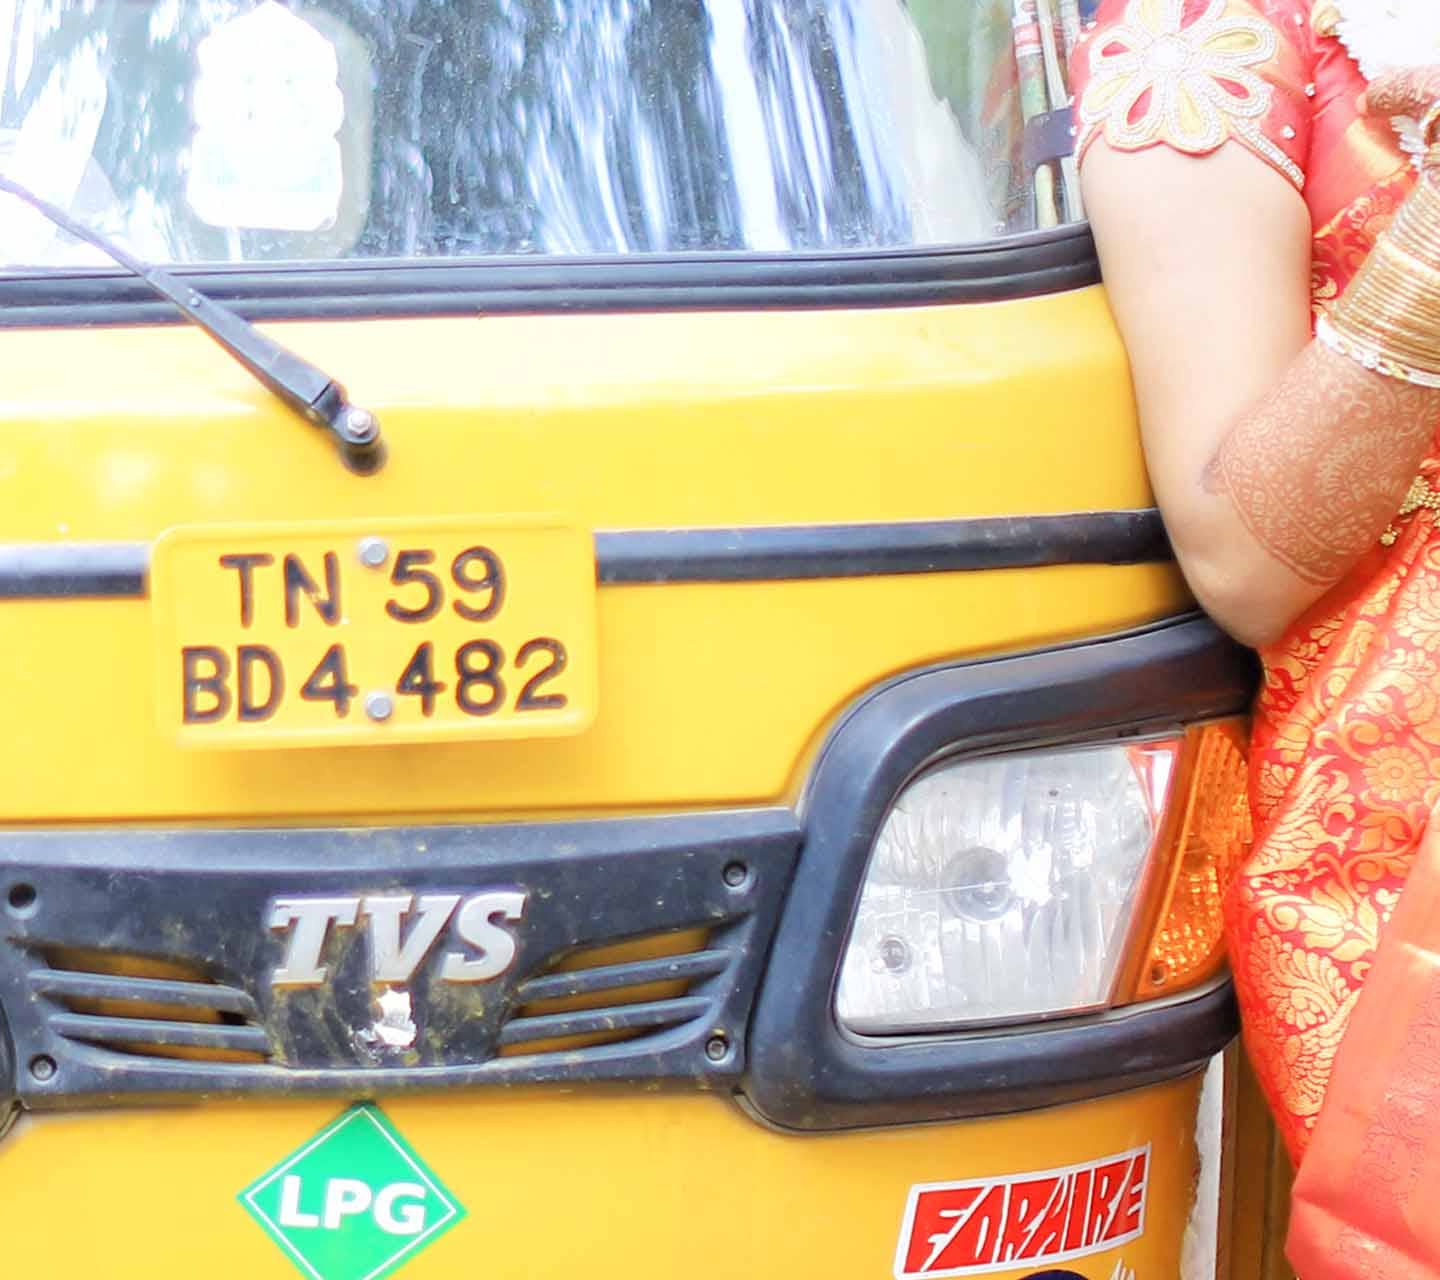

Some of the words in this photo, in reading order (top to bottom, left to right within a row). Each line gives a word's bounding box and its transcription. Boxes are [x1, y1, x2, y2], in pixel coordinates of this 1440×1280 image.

[219, 551, 342, 629] TN
[384, 545, 507, 624] 59
[270, 889, 526, 988] TVS
[278, 1174, 427, 1238] LPG
